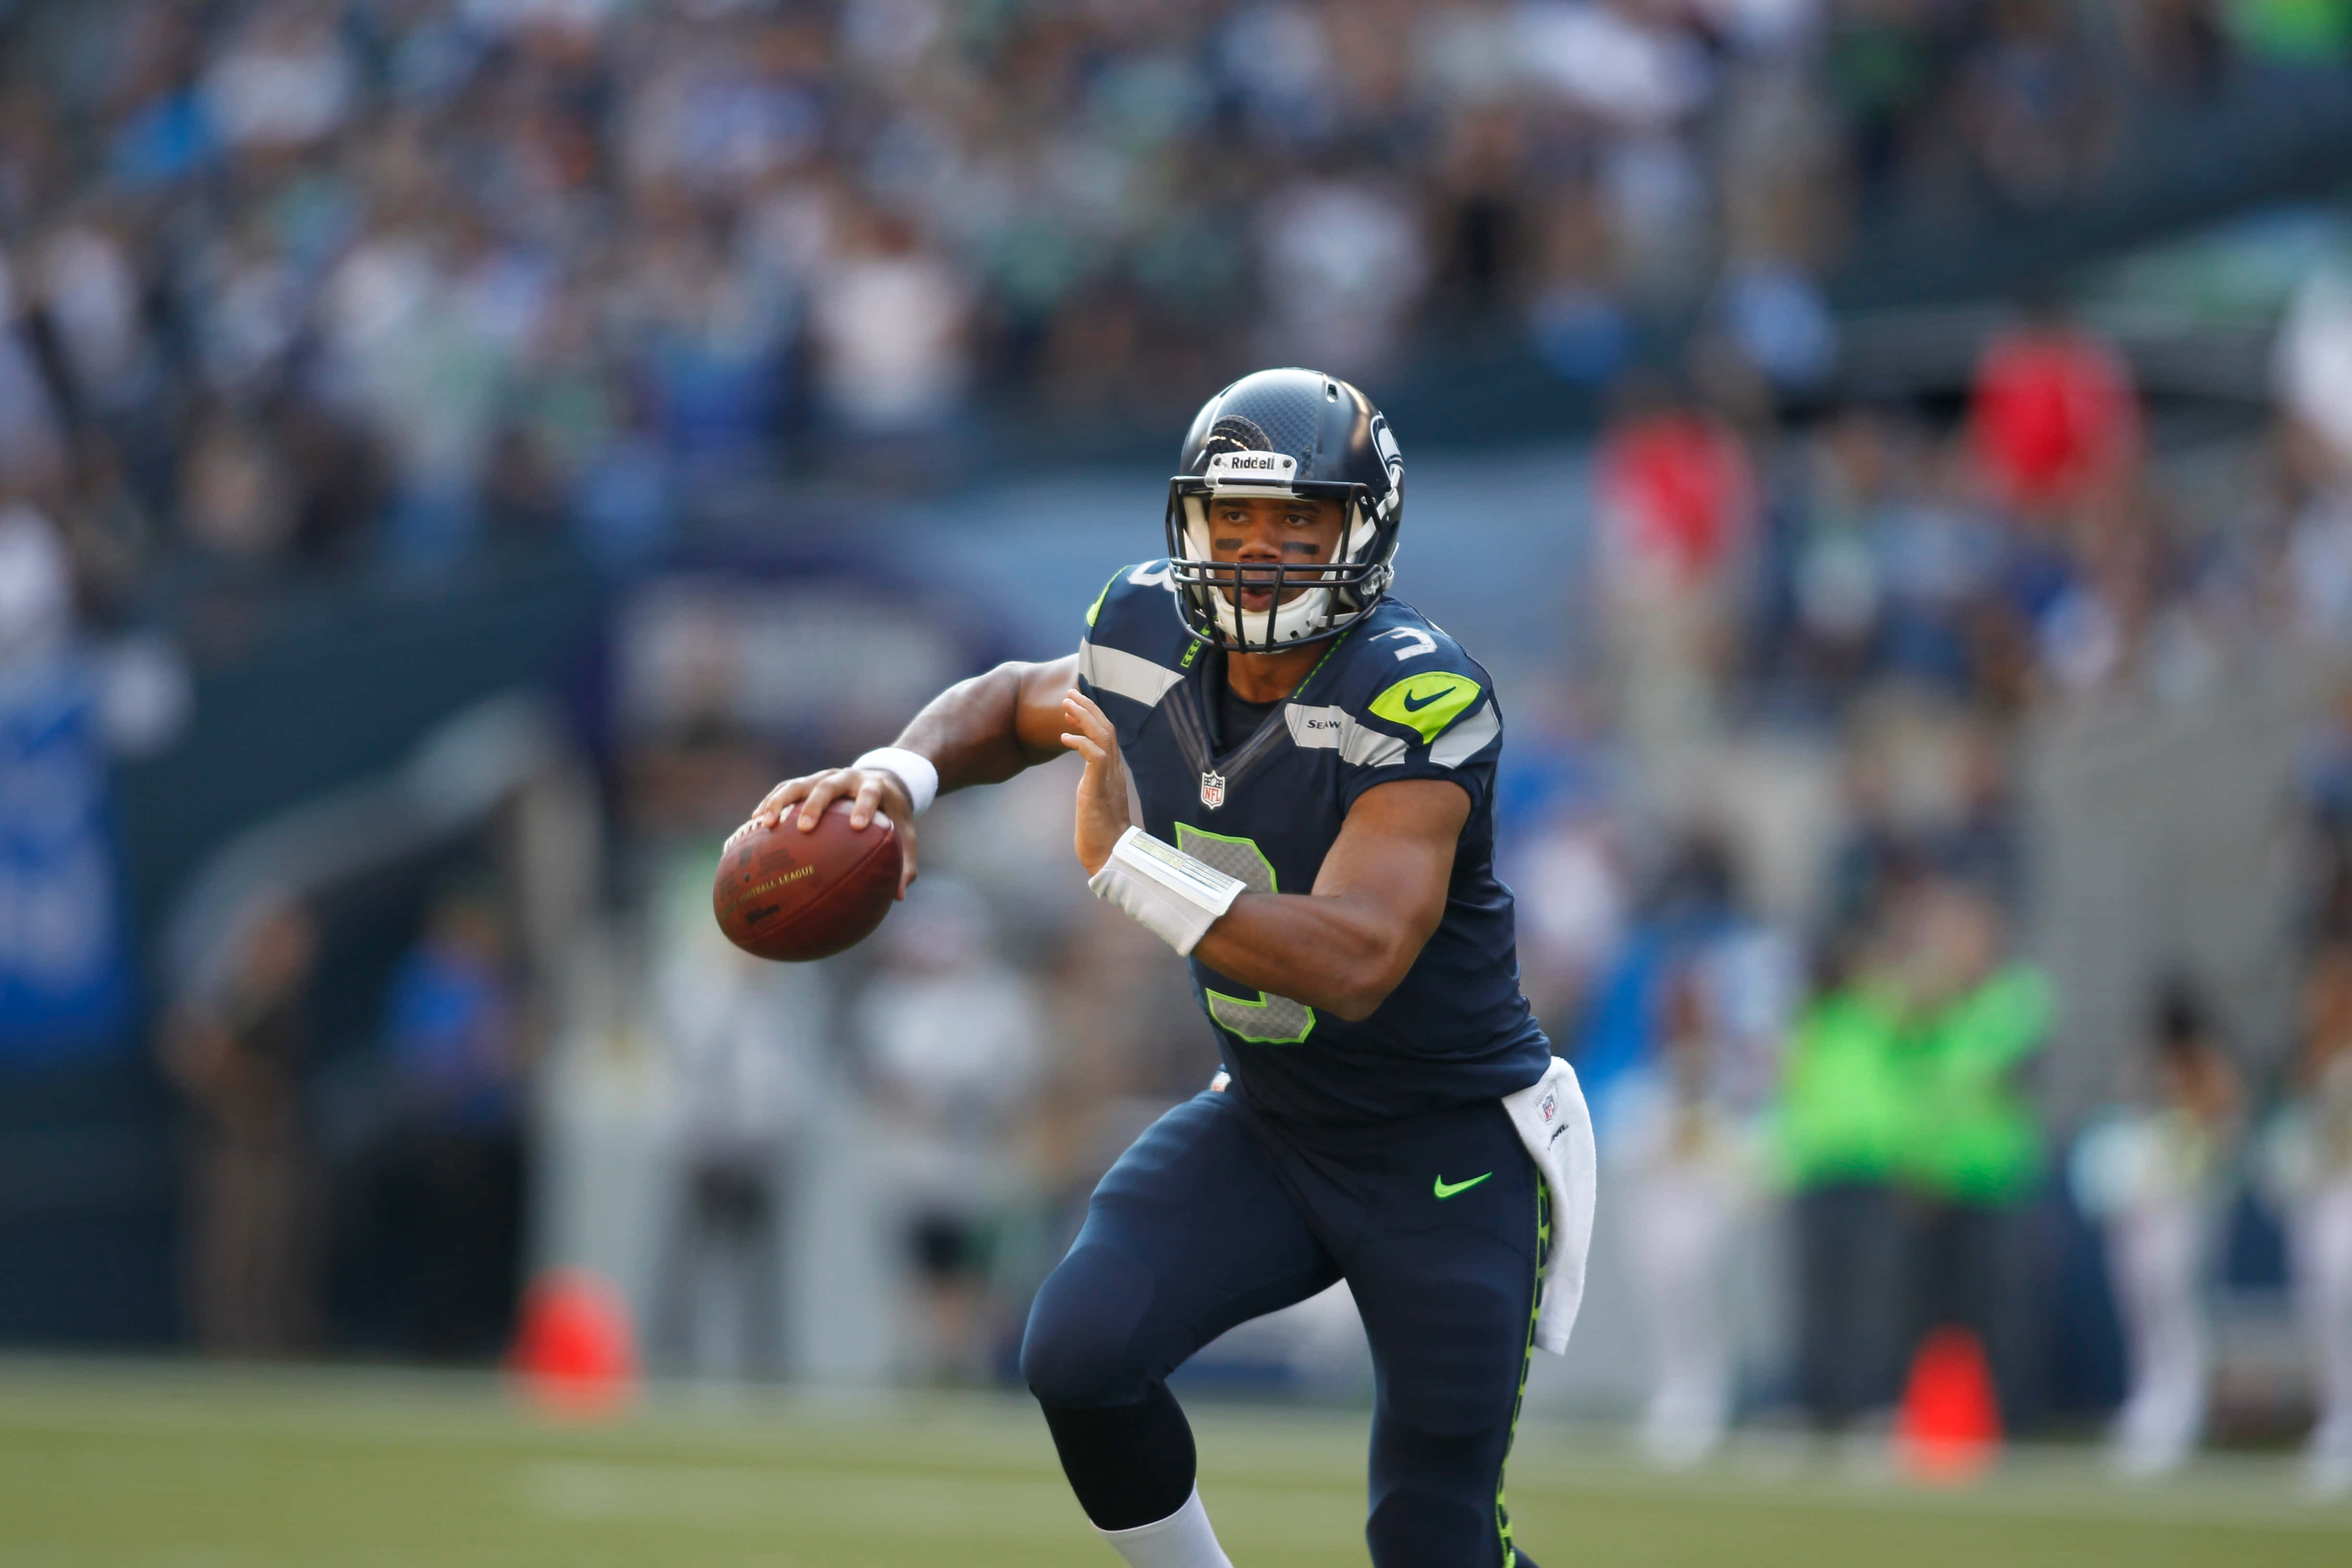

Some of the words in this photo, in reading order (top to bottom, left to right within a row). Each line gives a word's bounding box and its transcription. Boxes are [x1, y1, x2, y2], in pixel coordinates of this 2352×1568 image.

[1232, 456, 1275, 469] Riddell
[1369, 626, 1438, 661] 3
[1204, 786, 1221, 803] NFL
[779, 864, 815, 885] LEAGUE
